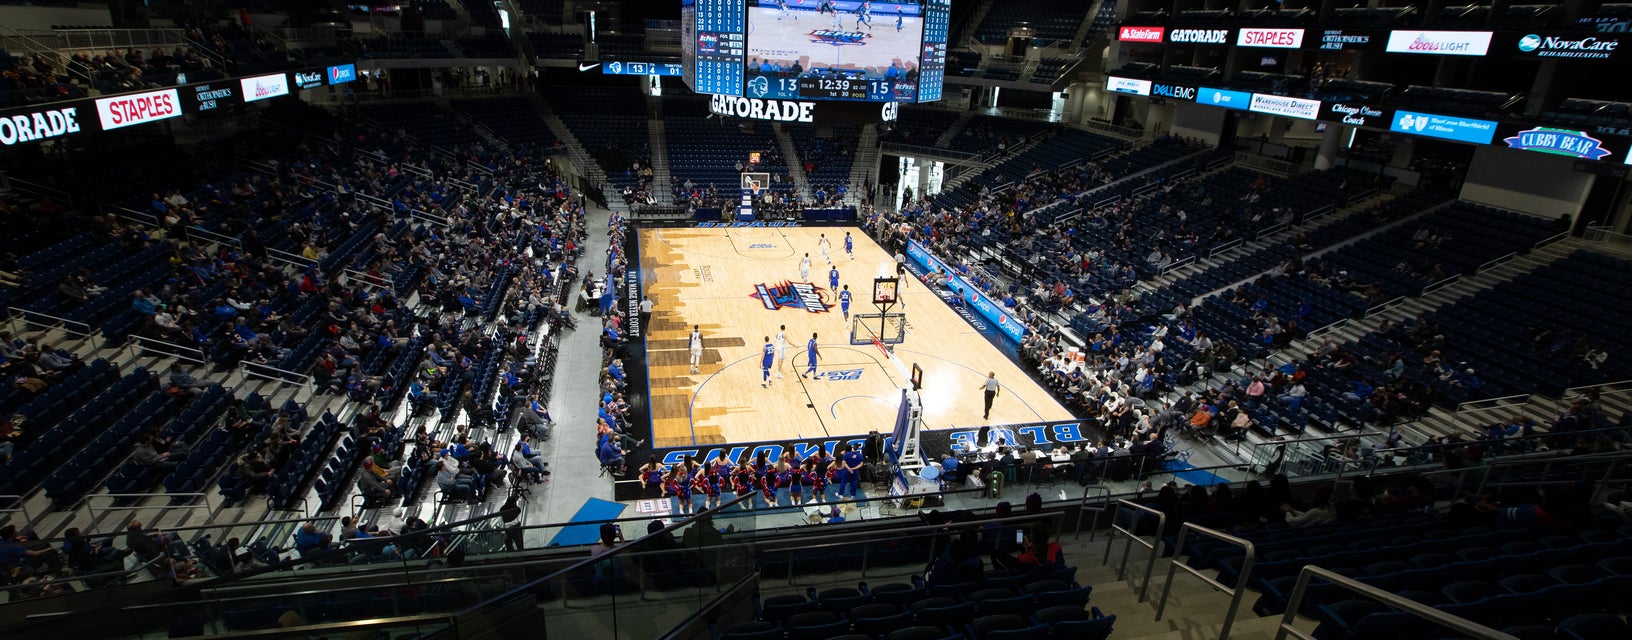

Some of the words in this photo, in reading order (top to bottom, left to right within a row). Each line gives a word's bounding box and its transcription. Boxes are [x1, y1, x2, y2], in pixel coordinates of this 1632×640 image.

[1170, 29, 1228, 43] GATORADE
[1245, 31, 1295, 46] STAPLES
[1541, 36, 1617, 50] NovaCare
[1409, 37, 1439, 51] Coors
[1440, 42, 1470, 51] LIGHT
[632, 64, 643, 72] 13
[779, 79, 797, 91] 13
[818, 80, 850, 90] 12:39
[872, 82, 889, 94] 15
[109, 94, 173, 125] STAPLES
[712, 94, 814, 122] GATORADE
[1332, 104, 1359, 115] Chicago
[1342, 115, 1364, 125] Coach
[1521, 133, 1558, 148] CUBBY
[1560, 138, 1593, 154] BEAR
[977, 300, 991, 312] pepsi
[630, 317, 640, 337] COURT
[1006, 322, 1020, 336] pepsi
